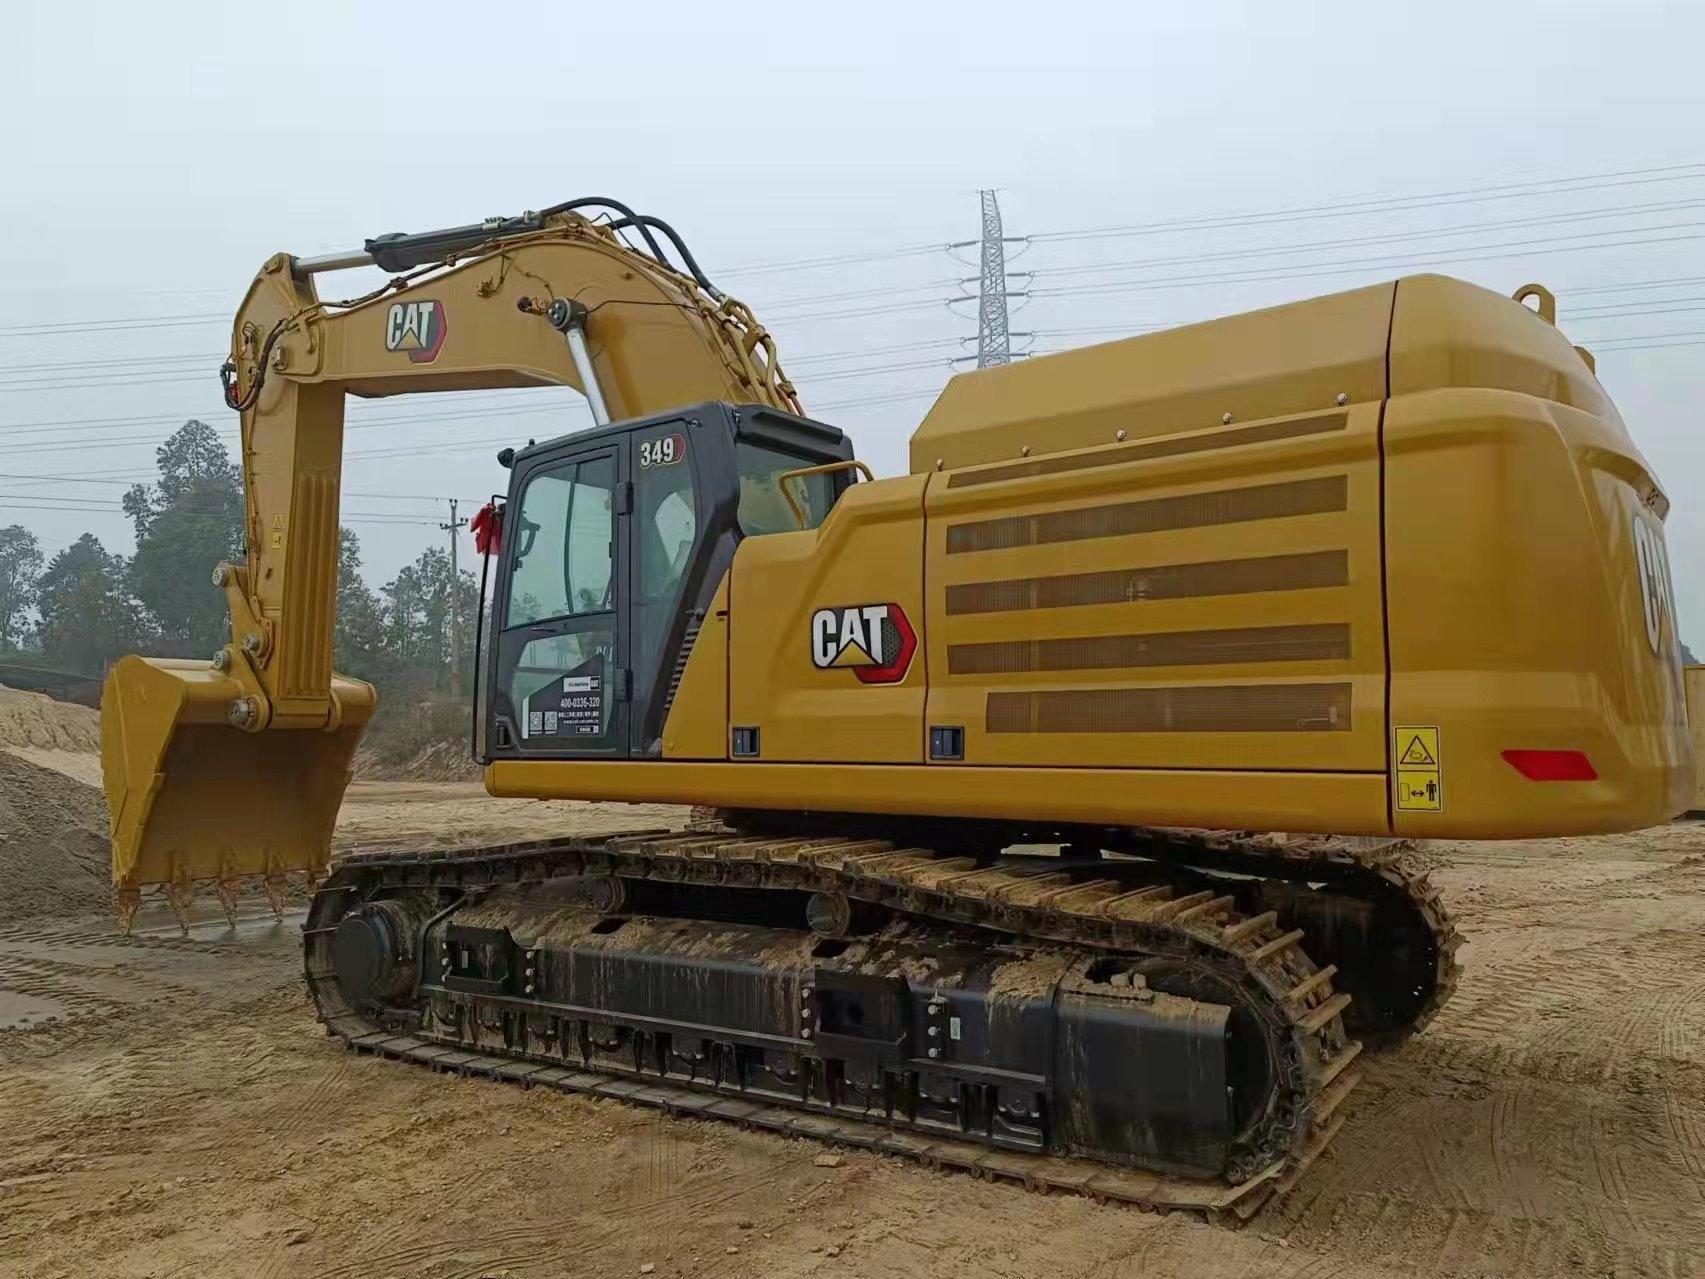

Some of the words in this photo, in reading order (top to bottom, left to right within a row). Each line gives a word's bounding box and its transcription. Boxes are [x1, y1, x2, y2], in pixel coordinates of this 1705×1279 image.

[386, 301, 435, 350] CAT
[640, 437, 674, 467] 349
[812, 605, 888, 667] CAT
